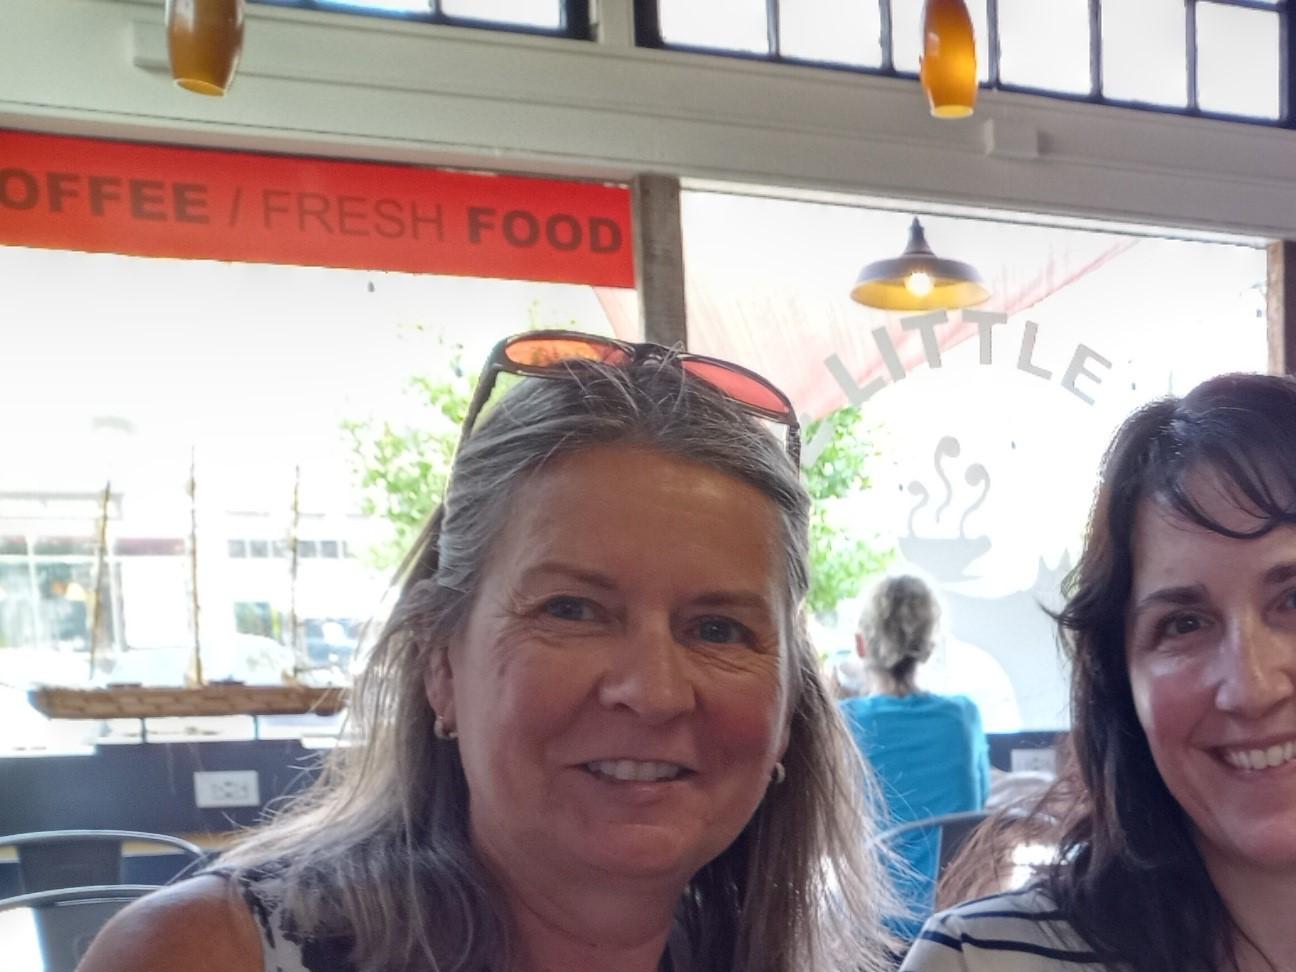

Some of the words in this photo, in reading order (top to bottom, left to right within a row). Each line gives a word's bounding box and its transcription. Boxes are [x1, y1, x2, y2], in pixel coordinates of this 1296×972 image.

[263, 190, 444, 241] FRESH
[467, 207, 623, 255] FOOD
[823, 309, 1112, 406] LITTLE
